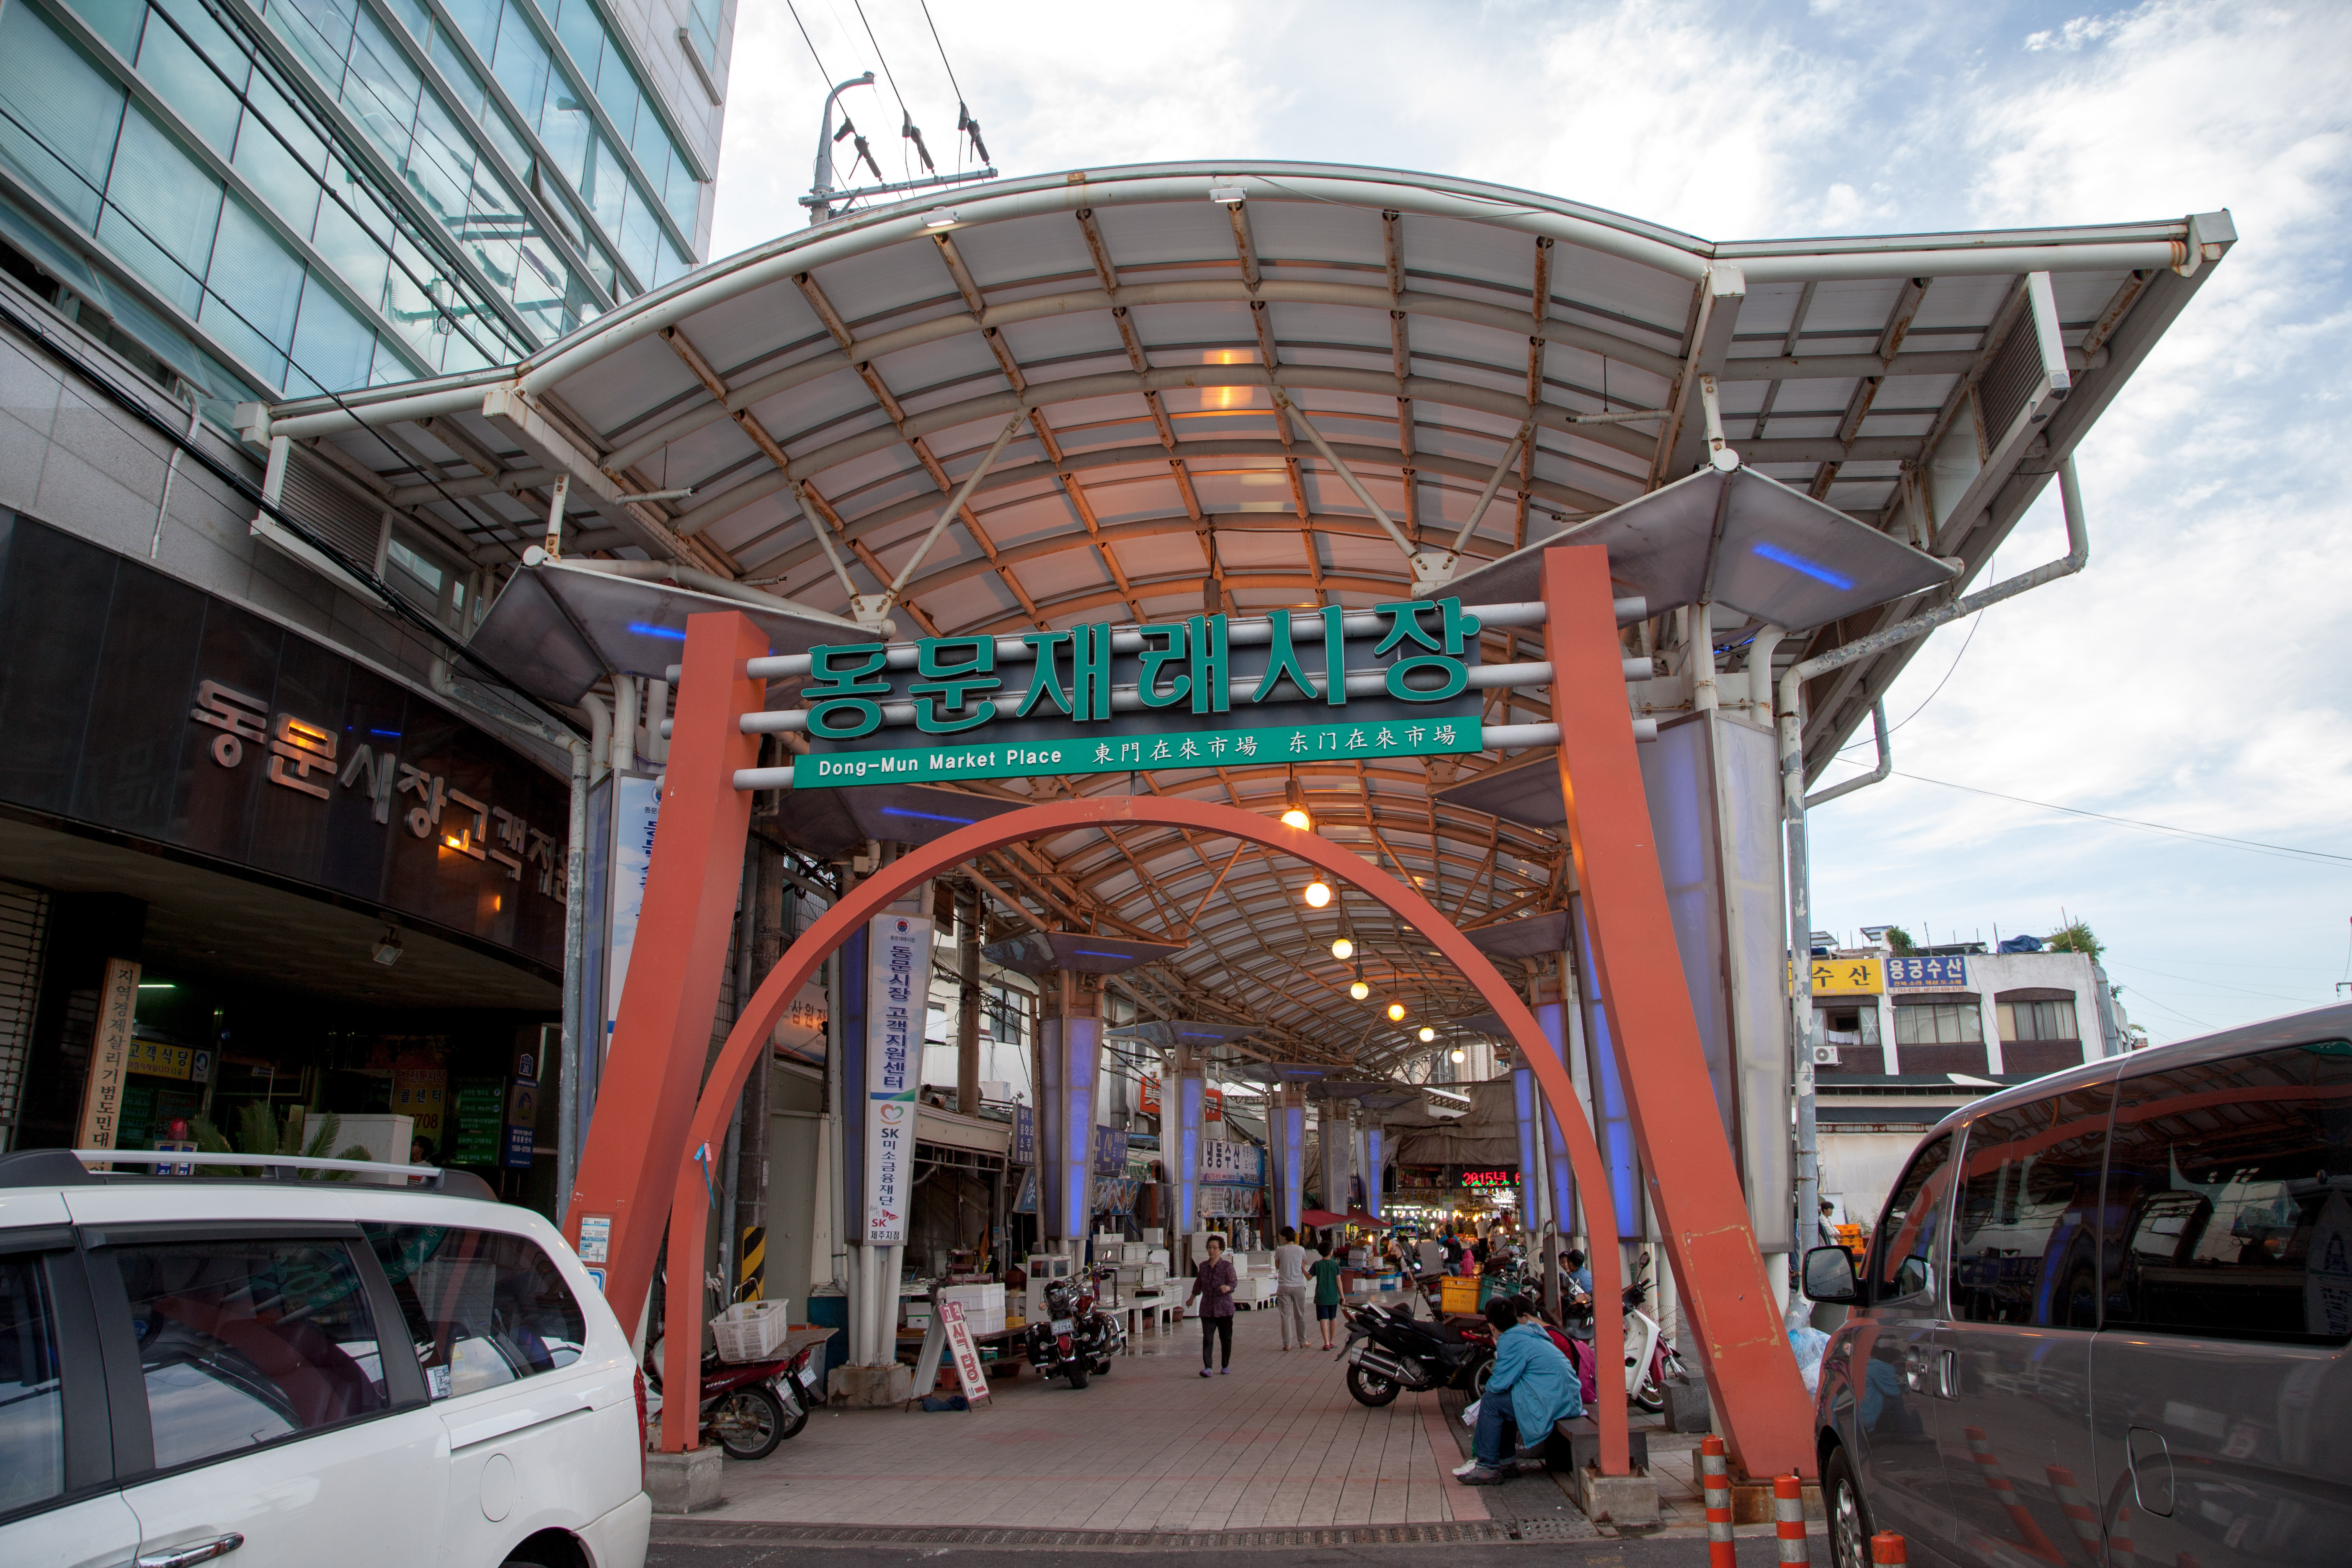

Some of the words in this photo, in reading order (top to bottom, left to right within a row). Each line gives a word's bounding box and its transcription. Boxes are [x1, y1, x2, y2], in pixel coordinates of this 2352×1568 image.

[799, 595, 1481, 740] 동문재래시장
[1092, 736, 1258, 765] 東門在來市場
[1290, 724, 1457, 751] 东门在來市場
[819, 756, 918, 777] Dong-Mun
[929, 751, 996, 770] Market
[1007, 749, 1062, 766] Place
[888, 945, 912, 1000] 동문시장
[1788, 965, 1871, 988] 수산
[1889, 958, 1962, 980] 용궁수산
[129, 1043, 188, 1067] 고객식당
[883, 1006, 908, 1089] 고객지원센터
[409, 1070, 446, 1085] 전통시장
[409, 1113, 438, 1129] 708
[881, 1128, 900, 1139] SK
[879, 1140, 896, 1206] 미소금융재단
[1462, 1171, 1507, 1186] 2015년
[871, 1218, 887, 1228] SK
[870, 1230, 900, 1240] 제주지점
[944, 1304, 962, 1322] 고객
[952, 1322, 979, 1383] 식당
